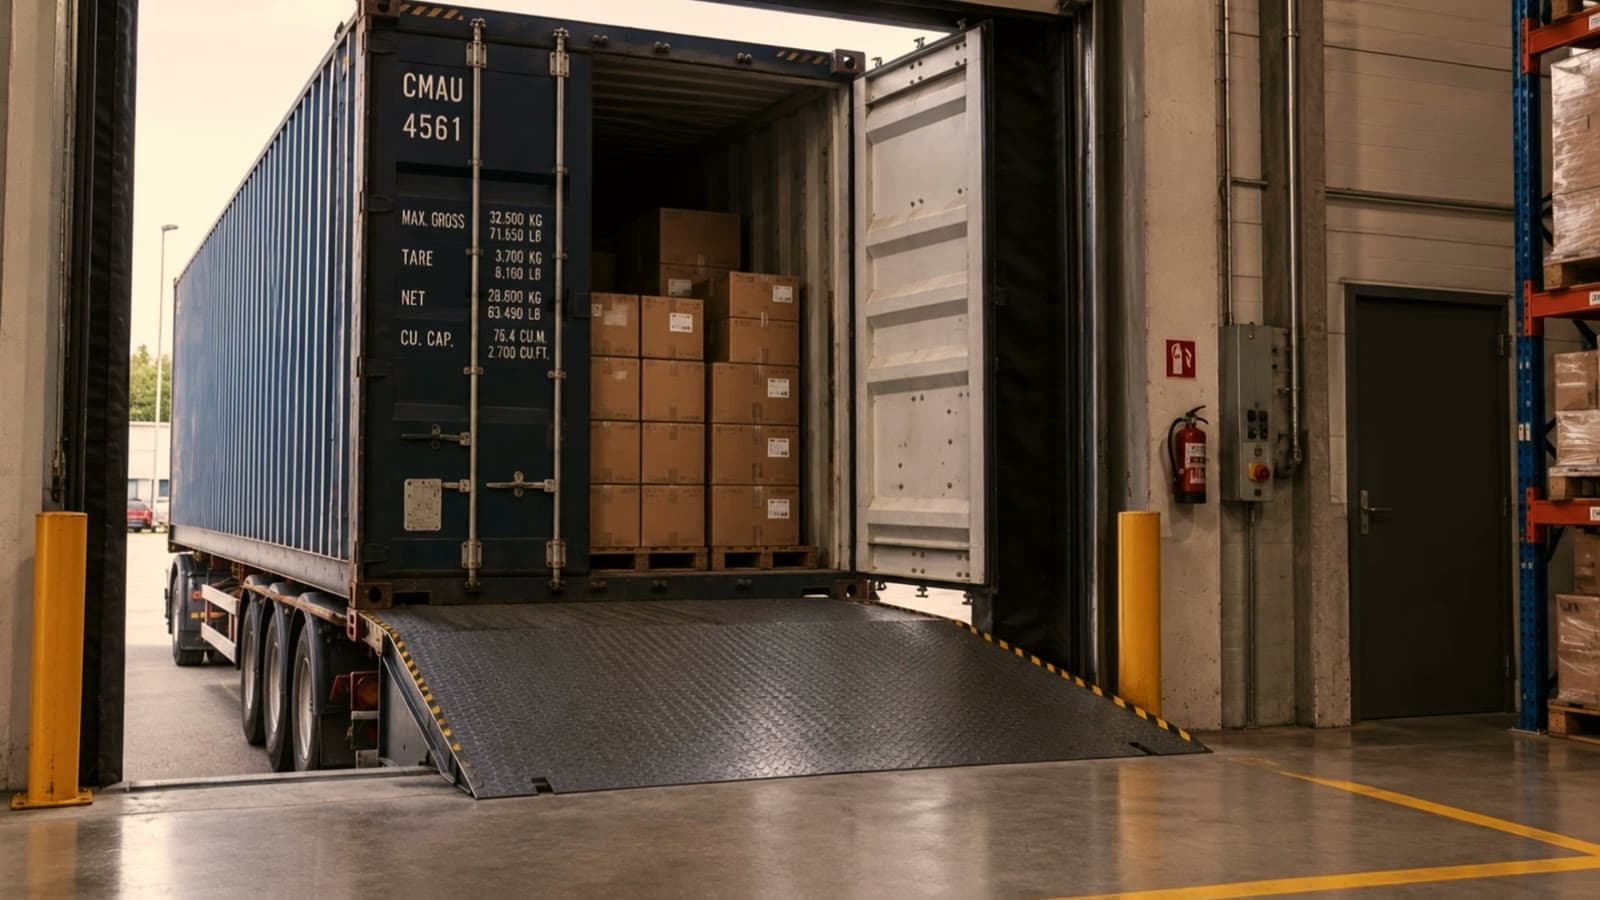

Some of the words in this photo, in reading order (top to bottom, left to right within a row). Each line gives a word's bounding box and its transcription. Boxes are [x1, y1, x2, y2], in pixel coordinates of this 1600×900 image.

[403, 72, 463, 103] CMAU
[402, 112, 461, 142] 4561
[402, 209, 427, 226] MAX.
[431, 212, 465, 229] GROSS
[489, 211, 524, 226] 32.500
[529, 214, 543, 227] KG
[489, 227, 524, 242] 71.650
[529, 230, 542, 243] LB
[401, 249, 433, 266] TARE
[495, 249, 524, 264] 3.700
[529, 252, 543, 265] KG
[495, 266, 524, 280] 8.160
[529, 268, 541, 281] LB
[401, 289, 426, 307] NET
[528, 291, 542, 305] KG
[528, 308, 541, 321] LB
[400, 329, 422, 346] CU.
[427, 331, 454, 348] CAP.
